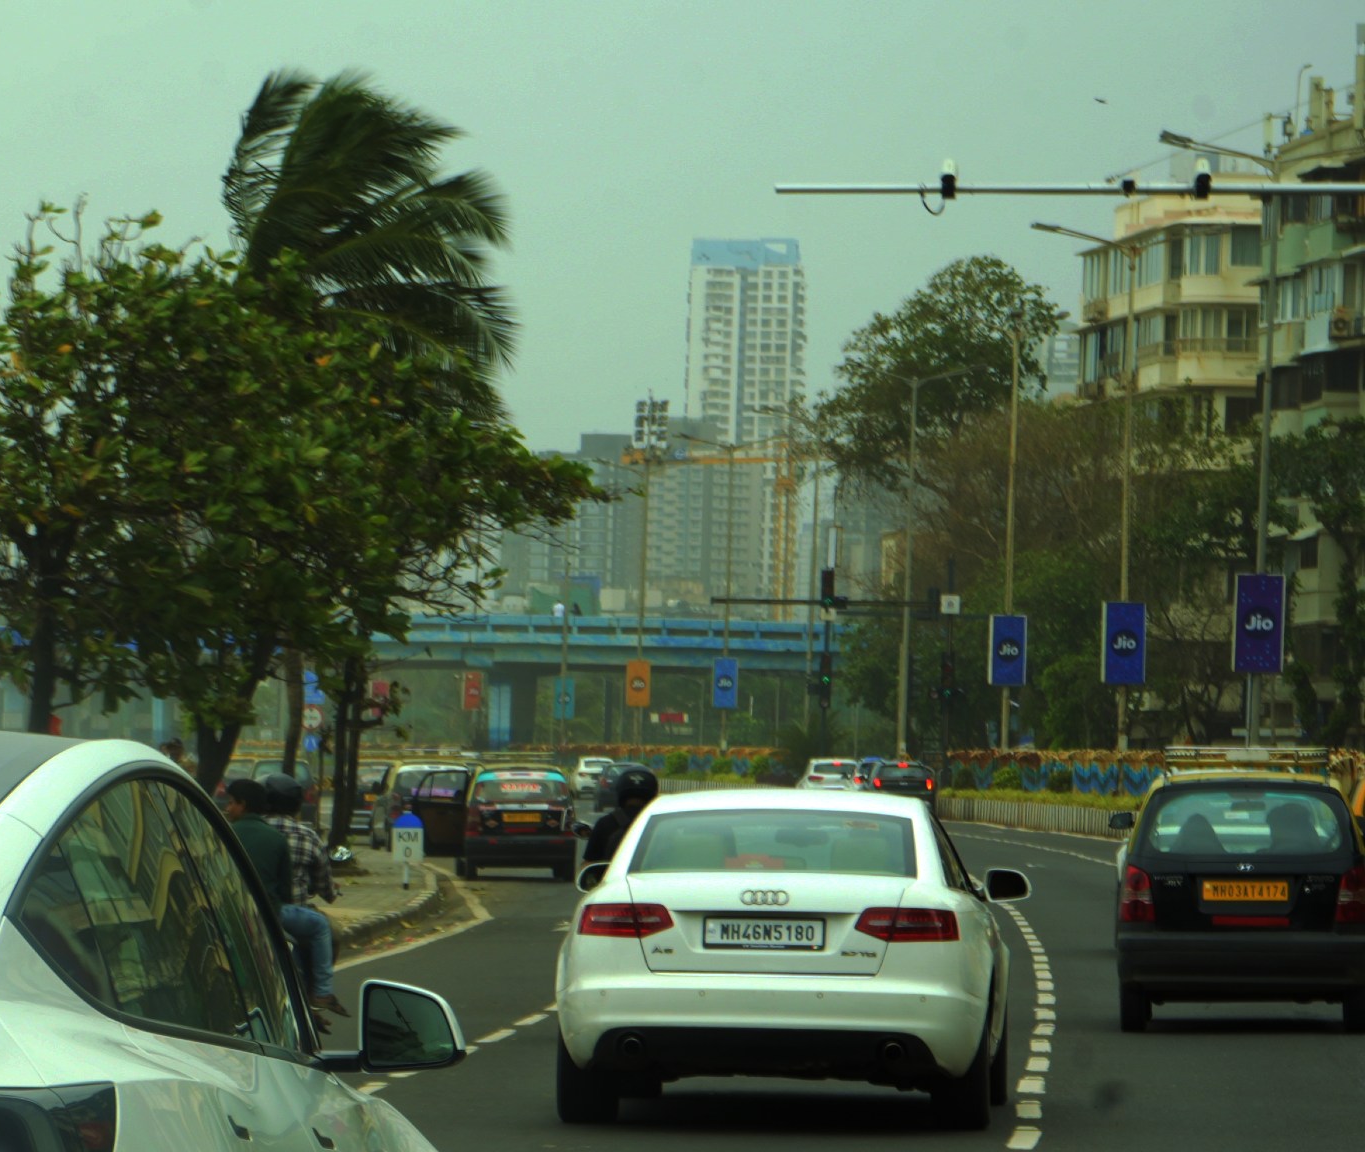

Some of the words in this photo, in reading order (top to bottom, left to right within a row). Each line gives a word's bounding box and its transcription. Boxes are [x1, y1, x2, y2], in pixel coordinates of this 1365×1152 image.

[1245, 614, 1274, 631] Jio
[1113, 635, 1137, 650] Jio
[999, 643, 1019, 656] Jio
[632, 680, 645, 689] Jio
[717, 678, 732, 688] Jio
[398, 831, 419, 843] KM
[404, 846, 412, 857] 0
[720, 923, 815, 942] MH46N5180
